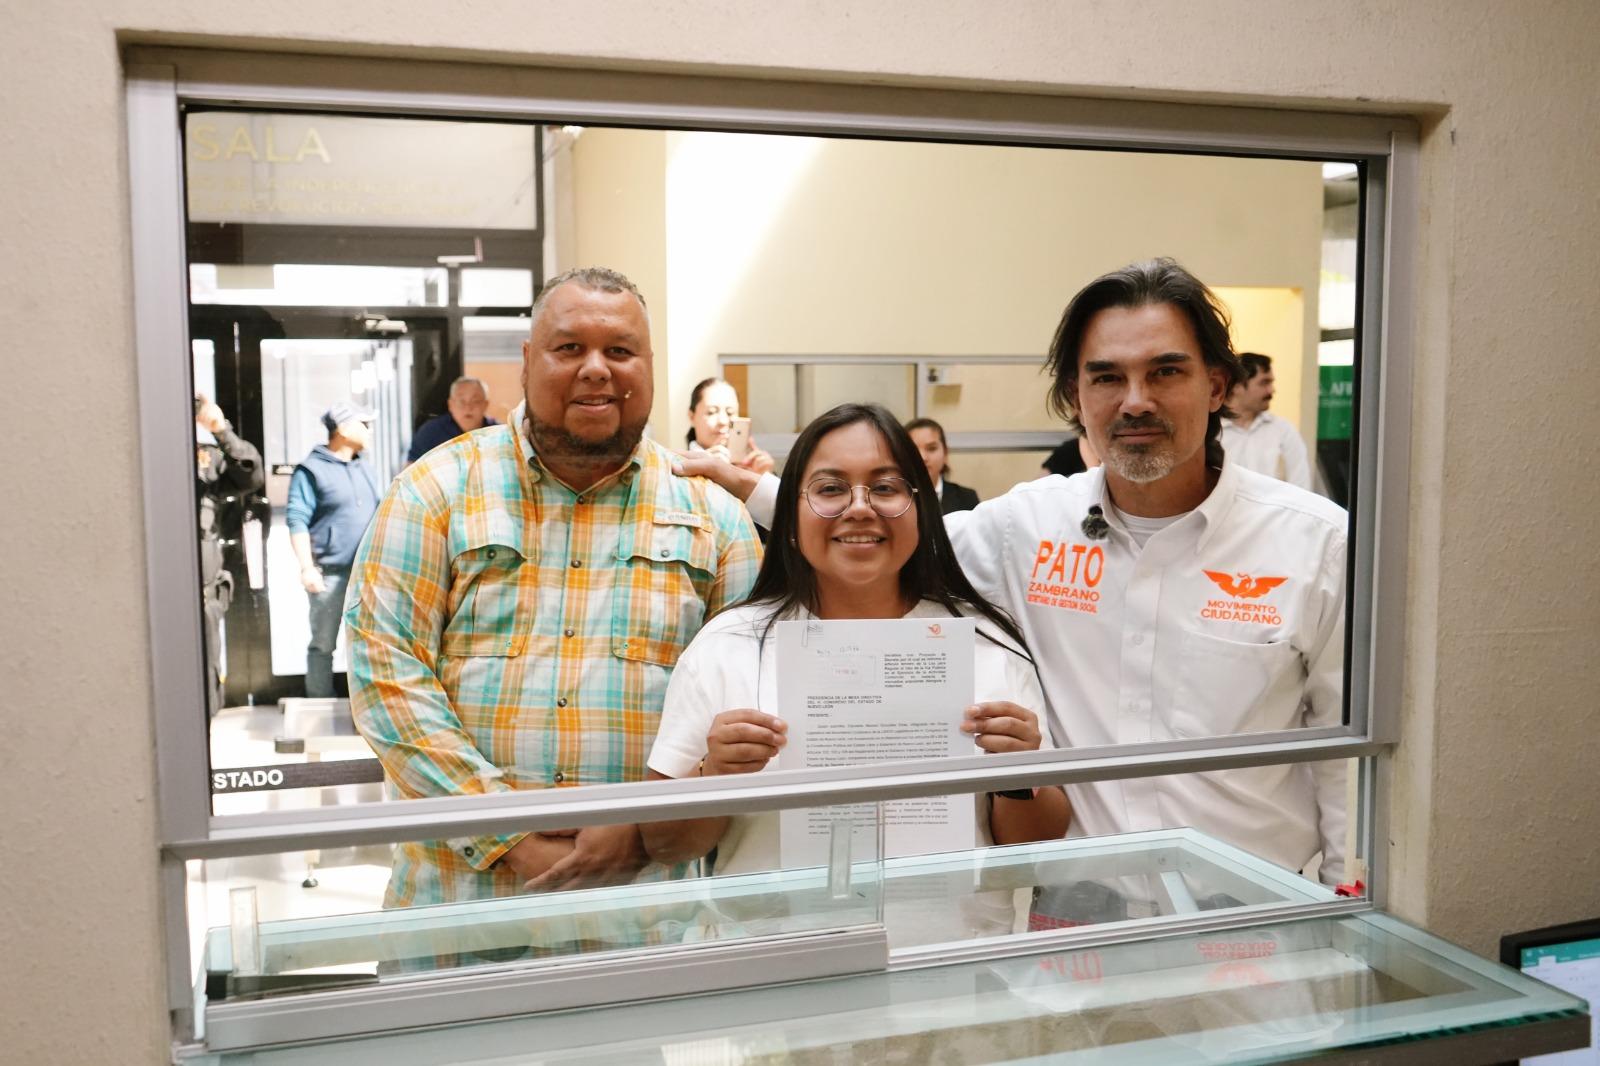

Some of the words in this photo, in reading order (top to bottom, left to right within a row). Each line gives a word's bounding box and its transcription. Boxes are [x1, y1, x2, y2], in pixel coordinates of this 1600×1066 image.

[191, 124, 332, 164] SALA
[1032, 540, 1105, 589] PATO
[1028, 582, 1100, 602] ZAMBRANO
[1200, 608, 1282, 625] CIUDADANO
[1207, 600, 1277, 614] MOVIMIENTO
[212, 769, 284, 789] STADO
